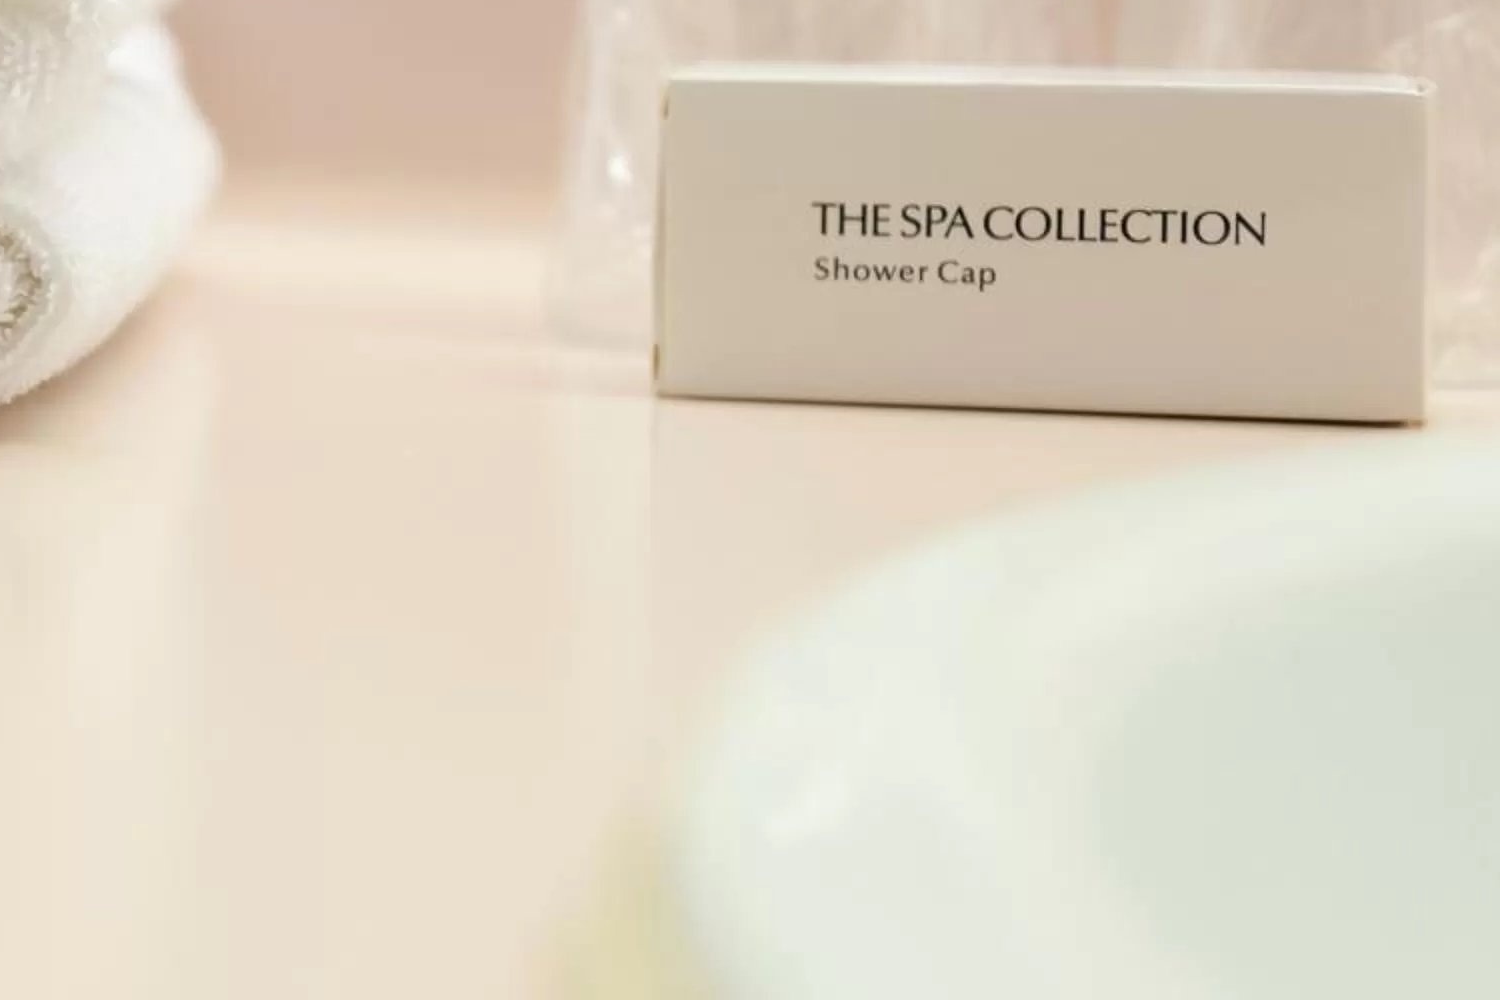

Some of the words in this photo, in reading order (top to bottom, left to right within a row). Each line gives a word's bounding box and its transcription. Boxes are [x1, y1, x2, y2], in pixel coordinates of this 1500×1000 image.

[811, 201, 891, 237] THE
[900, 203, 975, 239] SPA
[982, 205, 1267, 246] COLLECTION
[813, 256, 929, 283] Shower
[937, 260, 997, 292] Cap
